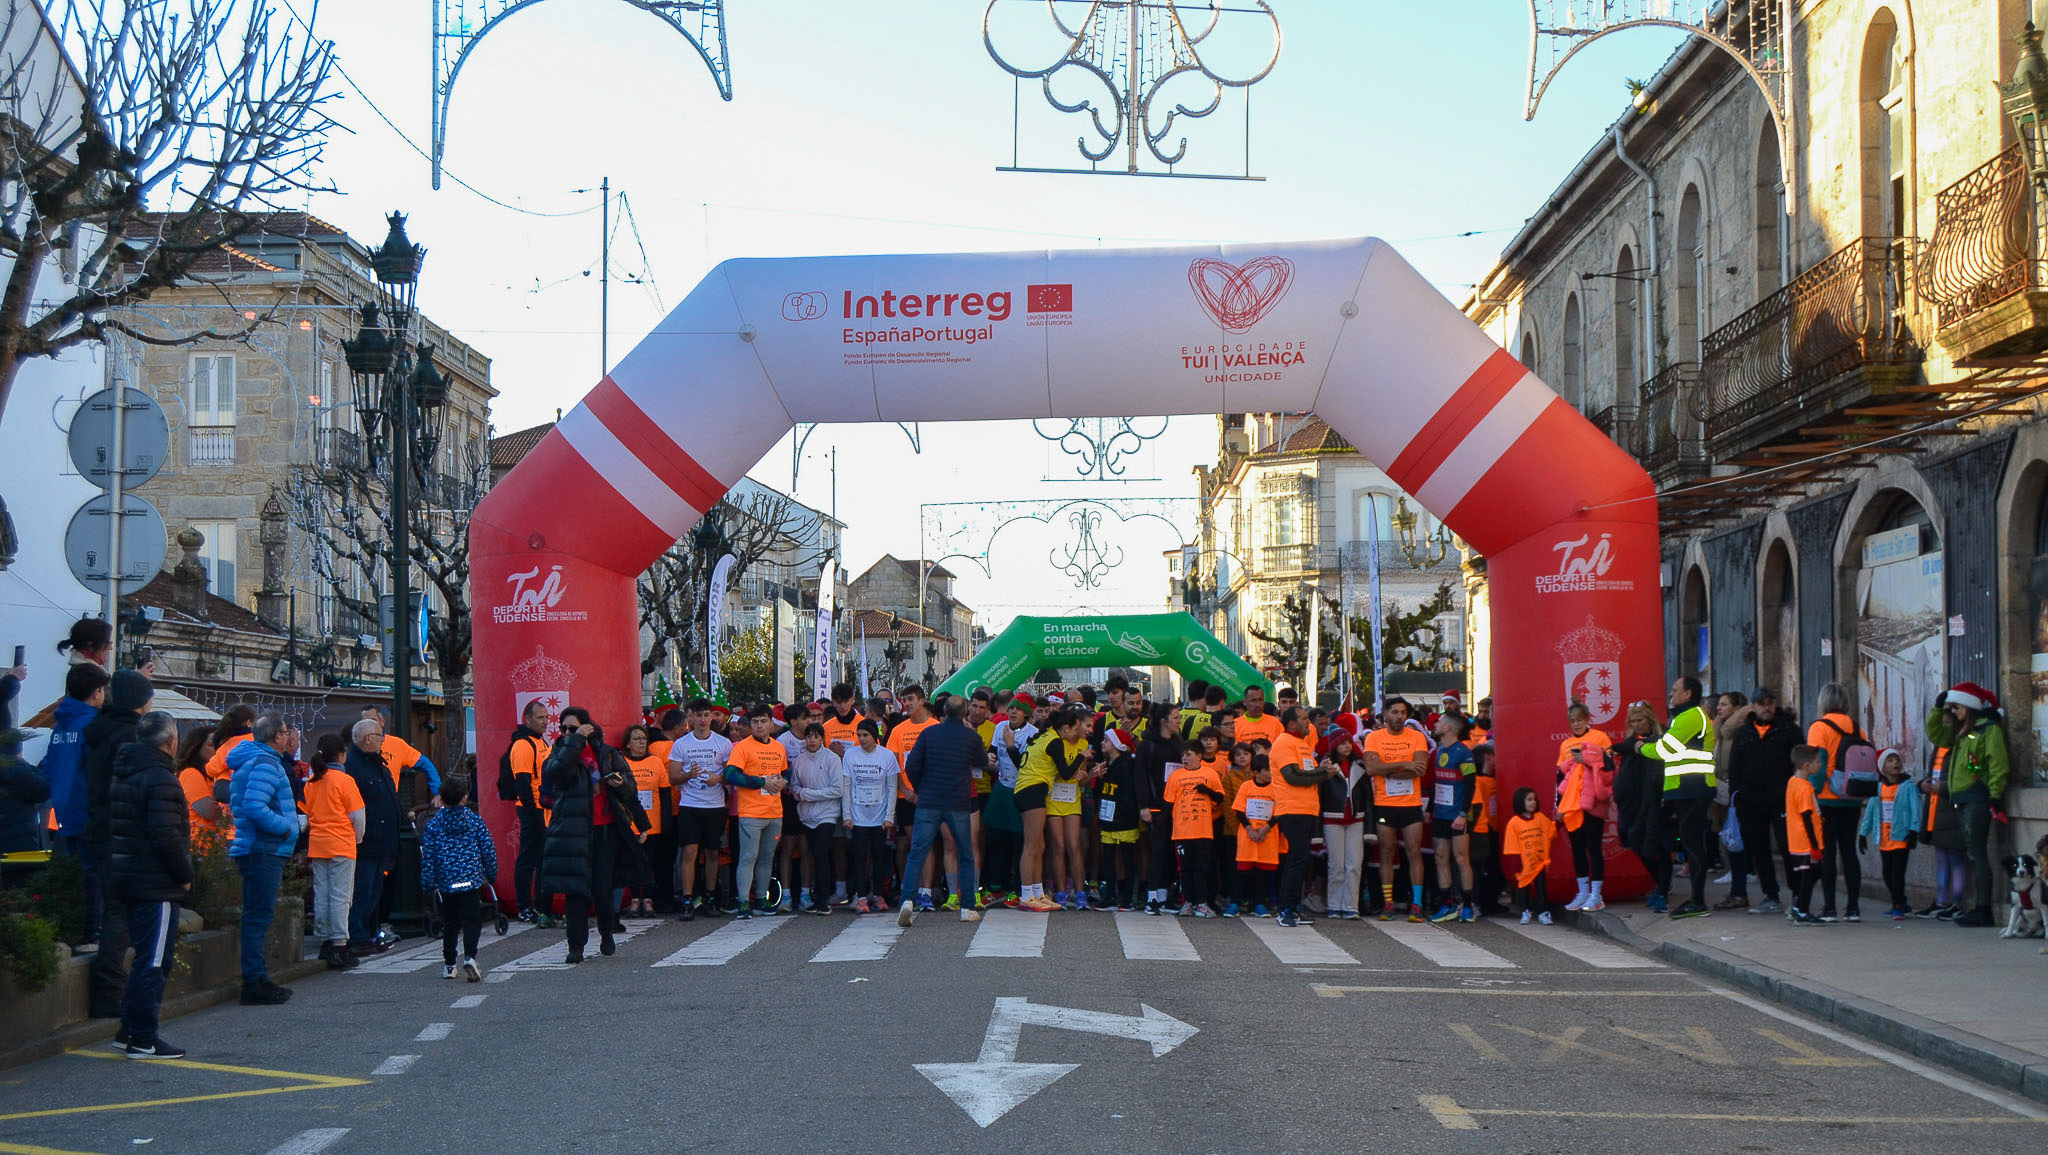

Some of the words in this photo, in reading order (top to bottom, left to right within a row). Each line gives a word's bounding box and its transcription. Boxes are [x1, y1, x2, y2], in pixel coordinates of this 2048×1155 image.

[843, 289, 1012, 321] Interreg
[843, 324, 993, 346] EspañaPortugal
[1181, 341, 1306, 354] EUROCIDADE
[1182, 355, 1209, 368] TUI
[1223, 351, 1305, 368] VALENÇA
[1204, 371, 1282, 383] UNICIDADE
[1535, 573, 1596, 585] DEPORTE
[1535, 581, 1596, 594] TUDENSE
[493, 603, 546, 615] DEPORTE
[493, 613, 547, 624] TUDENSE
[1043, 623, 1059, 633] En
[1061, 622, 1107, 632] marcha
[1043, 633, 1084, 644] contra
[1043, 645, 1056, 656] el
[1057, 645, 1101, 656] cáncer
